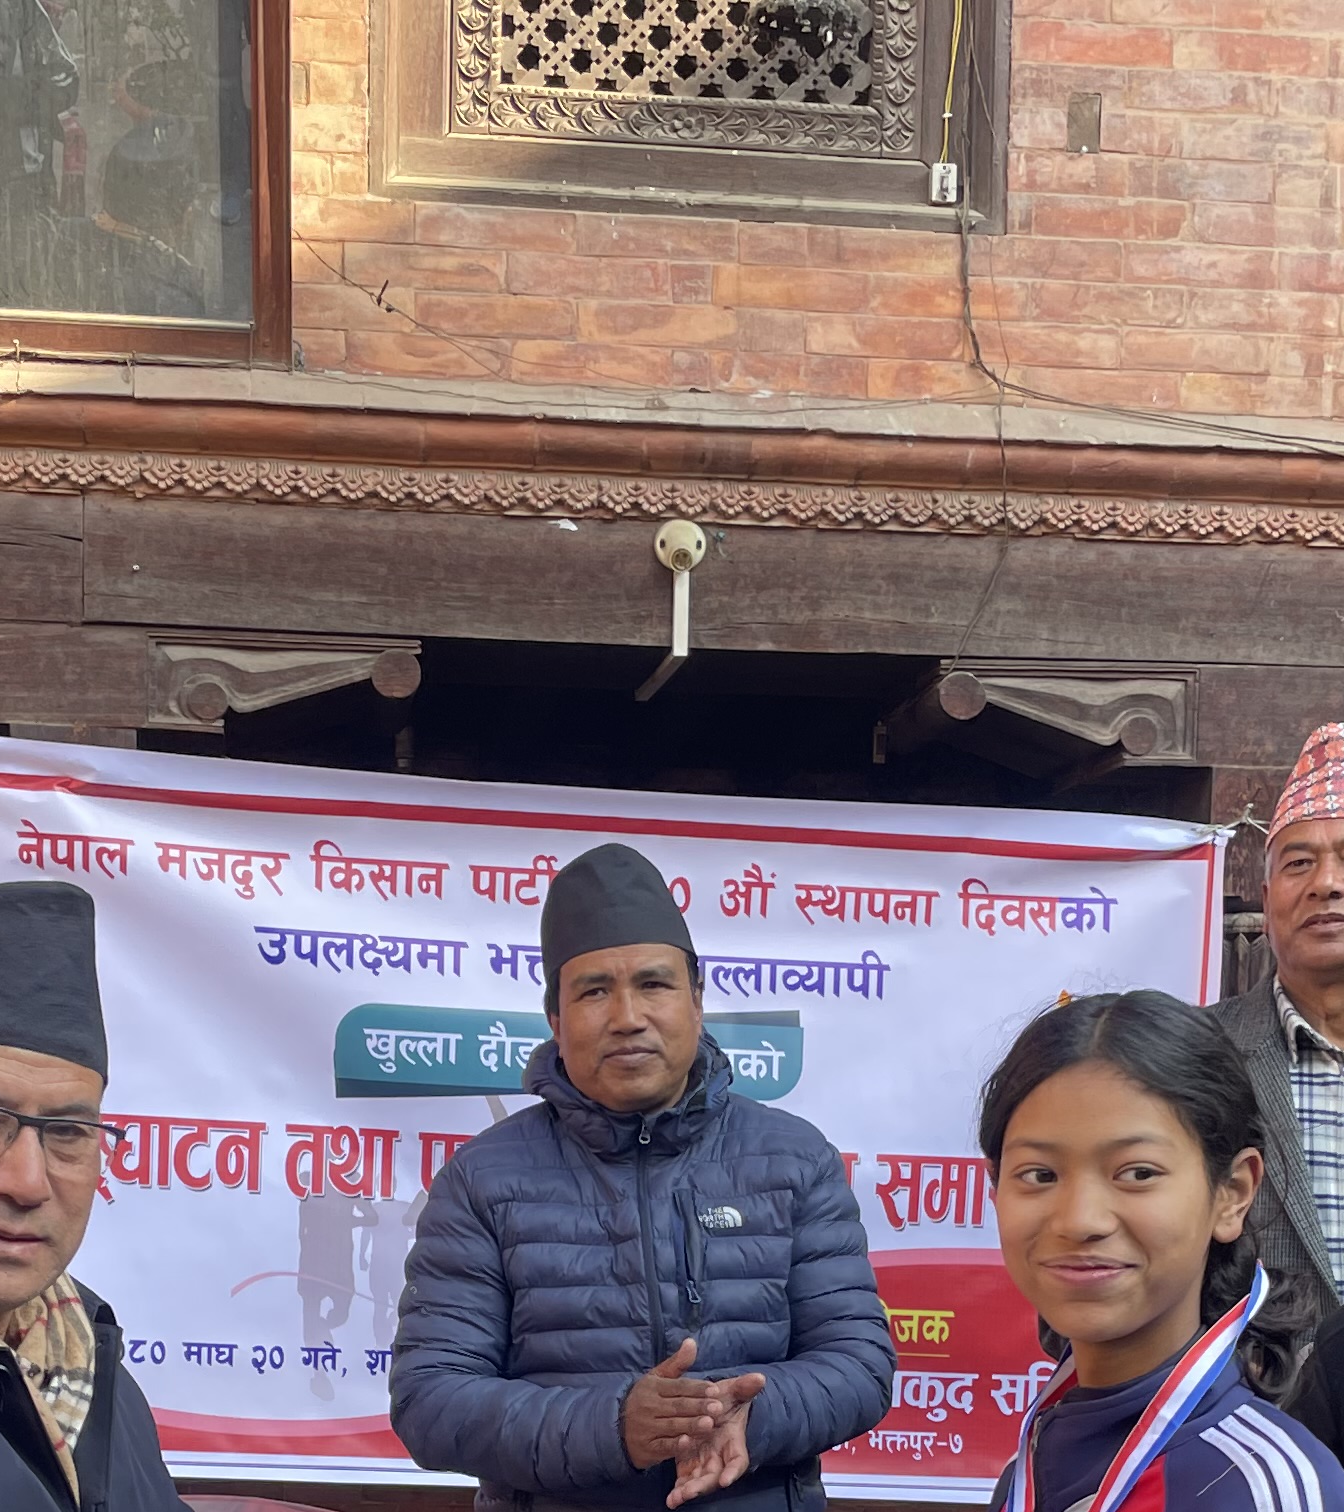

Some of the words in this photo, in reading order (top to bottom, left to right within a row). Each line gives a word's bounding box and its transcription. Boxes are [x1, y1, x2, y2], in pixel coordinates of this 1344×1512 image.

[17, 819, 134, 877] नेपाल
[156, 842, 289, 899] मजदुर
[311, 839, 449, 900] किसान
[720, 863, 776, 918] औं
[795, 883, 939, 925] स्थापना
[958, 878, 1117, 935] दिवसको
[254, 926, 469, 977] उपलक्ष्यमा
[362, 1027, 463, 1073] खुल्ला
[285, 1123, 400, 1200] तथा
[182, 1341, 238, 1368] माघ
[251, 1344, 285, 1375] २०
[301, 1341, 348, 1377] गते,
[868, 1429, 963, 1461] भक्तपुर-७
